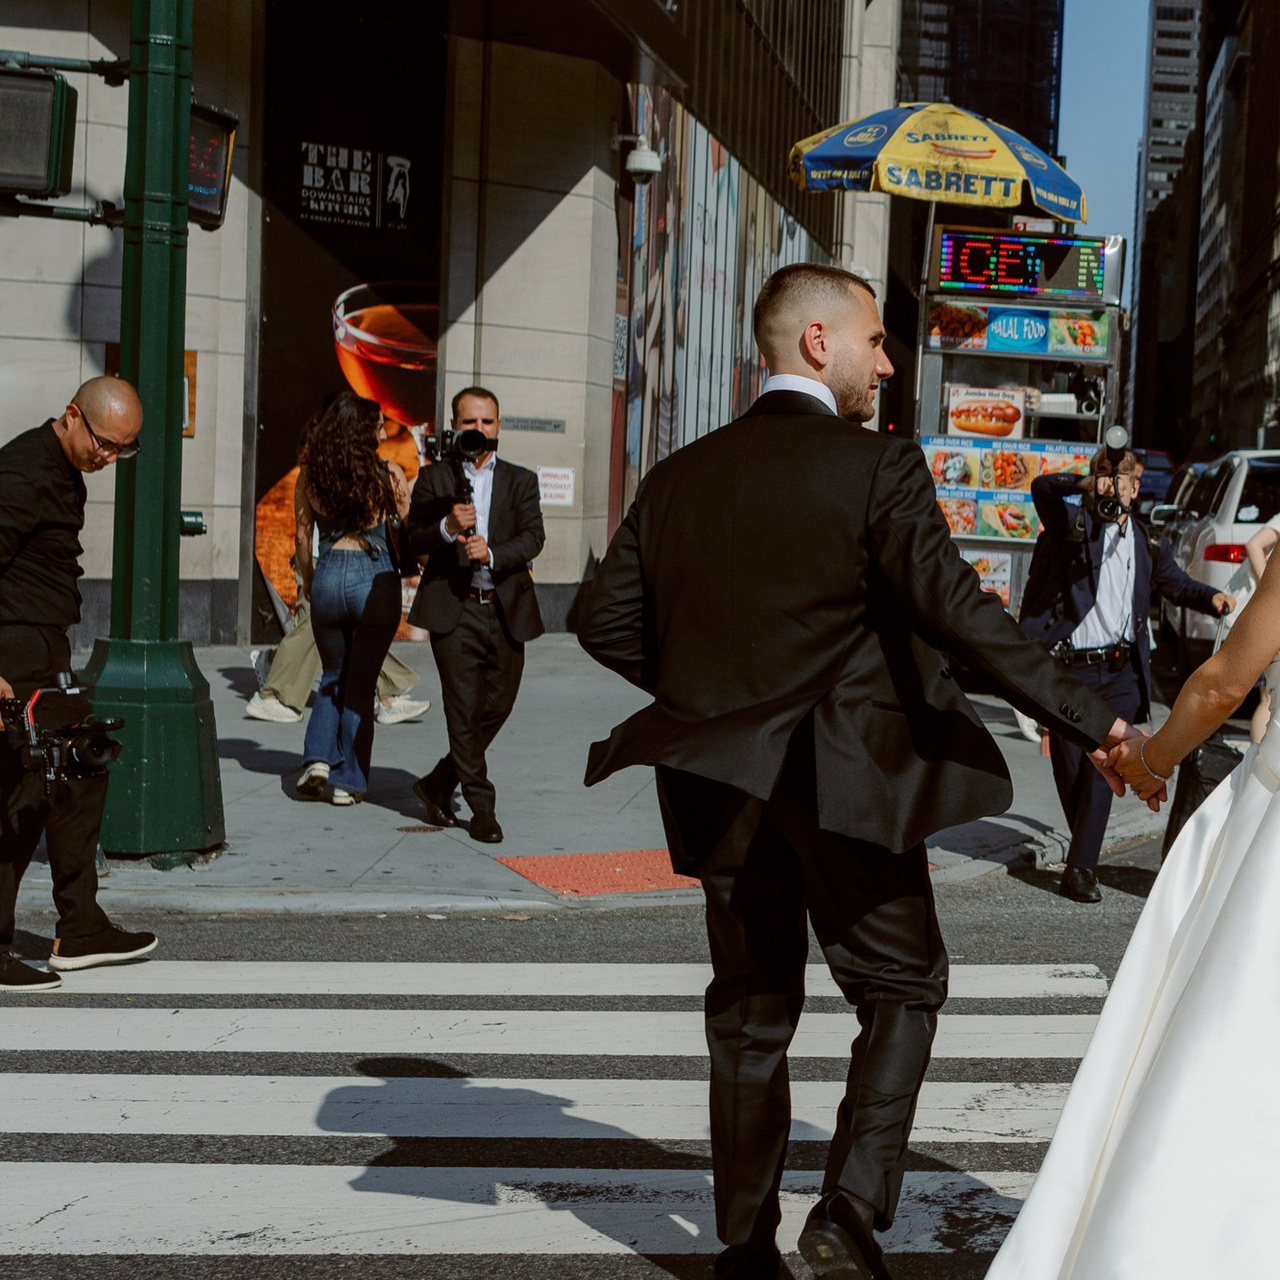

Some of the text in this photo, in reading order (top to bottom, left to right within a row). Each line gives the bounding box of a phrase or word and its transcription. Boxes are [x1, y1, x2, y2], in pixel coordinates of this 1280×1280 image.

[905, 132, 989, 144] SABRETT
[301, 141, 371, 172] THE
[303, 164, 371, 195] BAR
[886, 164, 1017, 198] SABRETT
[301, 188, 371, 206] DOWNSTAIRS
[309, 199, 370, 218] KITCHEN
[991, 317, 1046, 340] HALAL FOOD
